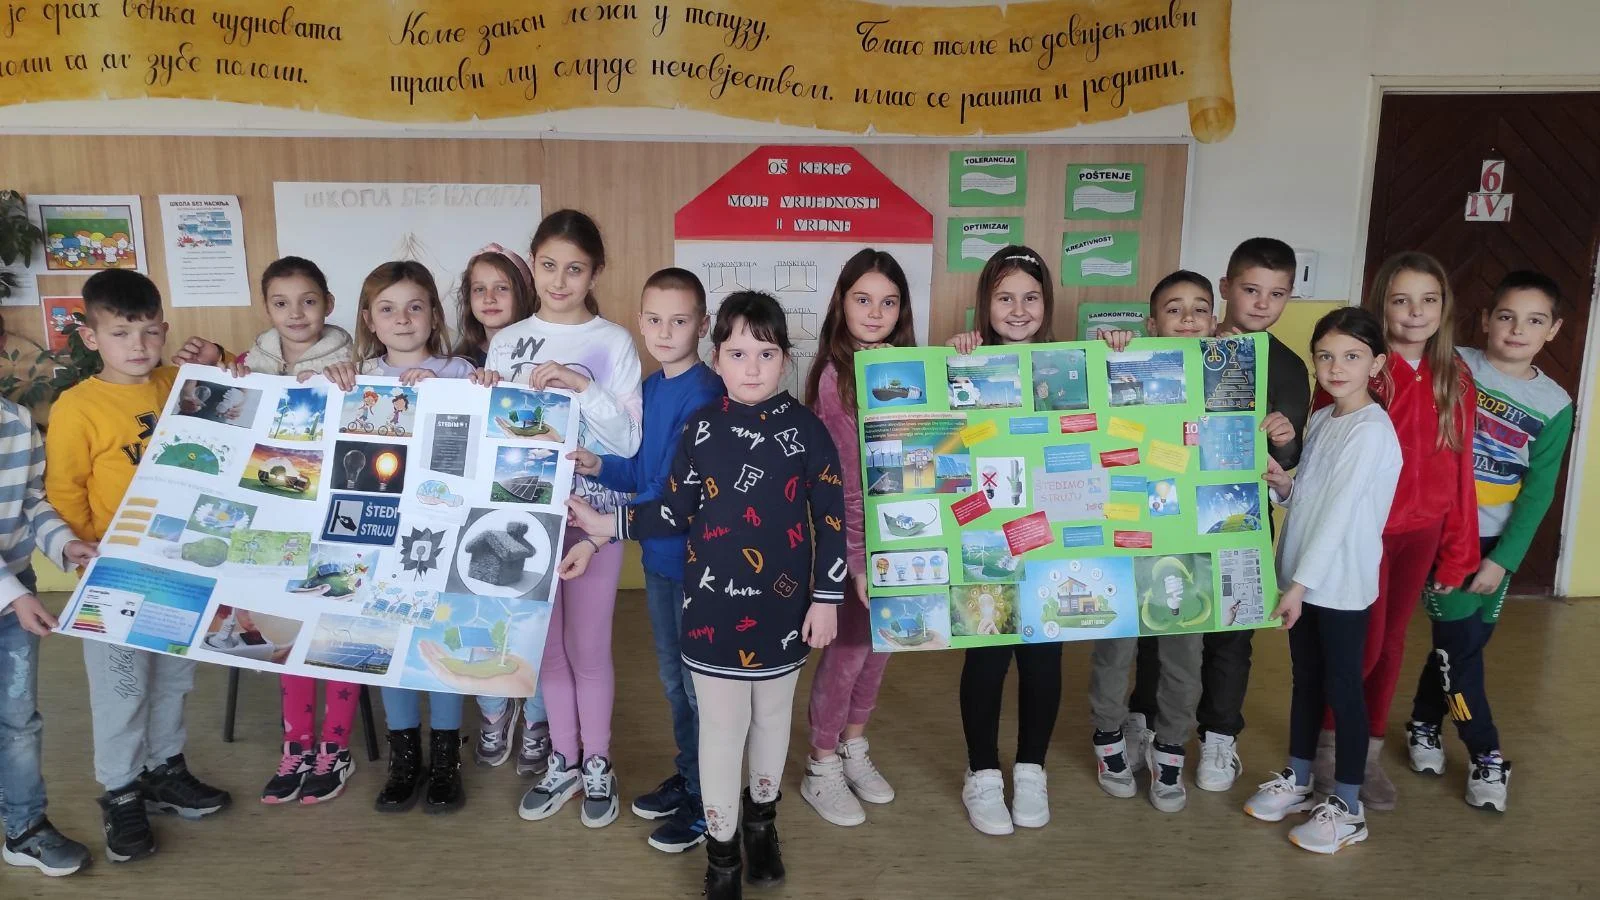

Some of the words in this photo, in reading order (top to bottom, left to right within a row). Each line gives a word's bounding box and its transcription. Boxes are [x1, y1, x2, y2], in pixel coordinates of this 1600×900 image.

[212, 5, 342, 47] чудновата
[388, 10, 466, 46] Коме
[477, 14, 546, 56] закон
[652, 5, 669, 38] у
[686, 7, 770, 51] топузу,
[856, 19, 924, 53] Благо
[933, 39, 998, 56] томе
[1009, 35, 1033, 54] ко
[1037, 13, 1128, 71] довијек
[1131, 0, 1197, 35] живи
[927, 91, 951, 108] се
[960, 86, 1042, 125] рашта
[1054, 83, 1068, 100] и
[1082, 60, 1185, 113] родити.
[768, 159, 788, 175] OŠ
[964, 156, 1015, 166] TOLERANCIJA
[1079, 171, 1131, 182] POŠTENJE
[1482, 161, 1505, 192] 6
[729, 195, 769, 208] MOJE
[781, 196, 880, 209] VRIJEDNOSTI
[777, 218, 783, 230] I
[795, 219, 851, 232] VRLINE
[963, 223, 1009, 232] OPTIMIZAM
[1065, 235, 1112, 253] KREATIVNOST
[1088, 310, 1144, 320] SAMOKONTROLA
[1476, 391, 1527, 425] ROPHY
[694, 420, 711, 447] B
[1184, 423, 1198, 434] 10
[773, 427, 806, 457] K
[733, 463, 764, 494] F
[365, 501, 398, 519] ŠTEDI
[360, 522, 396, 537] STRUJU
[786, 522, 804, 549] N
[698, 566, 716, 592] K
